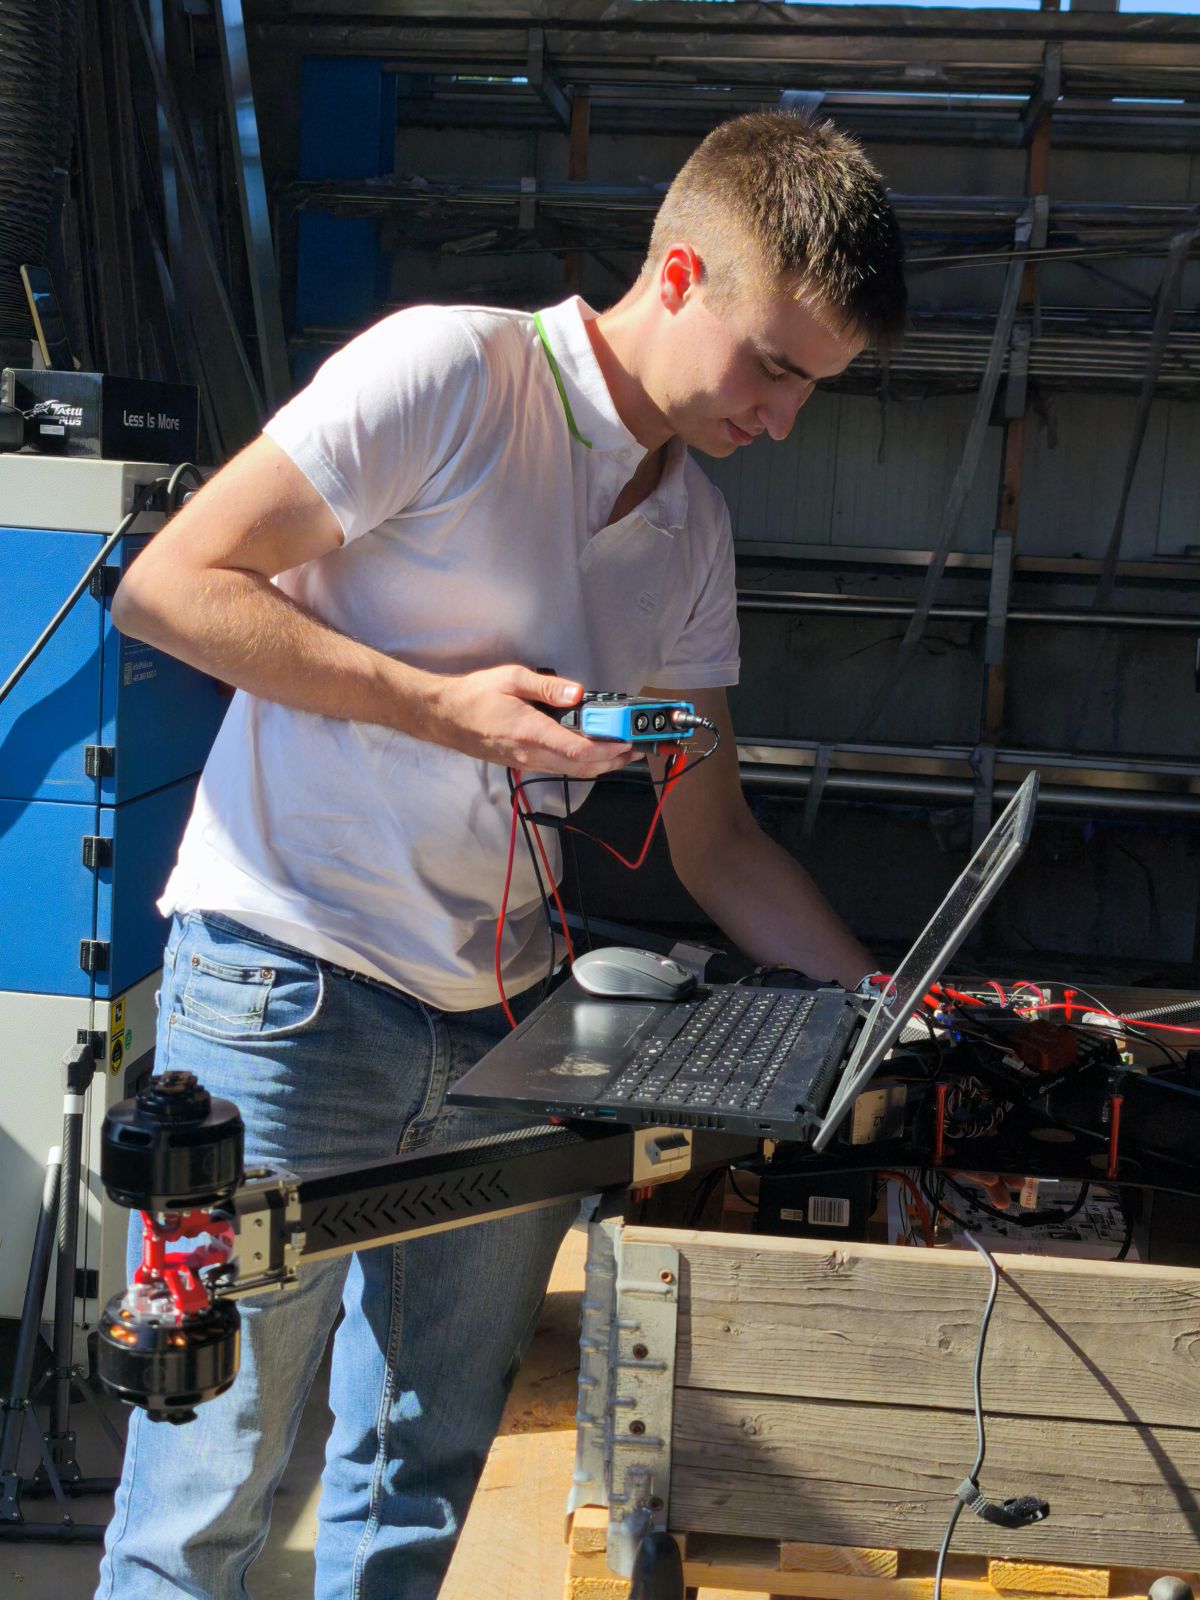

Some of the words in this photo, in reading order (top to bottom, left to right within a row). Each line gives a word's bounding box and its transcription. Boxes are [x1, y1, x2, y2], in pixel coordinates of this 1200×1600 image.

[58, 416, 82, 426] PLUS
[123, 410, 144, 427] Less
[147, 412, 155, 428] Is
[158, 413, 179, 430] More
